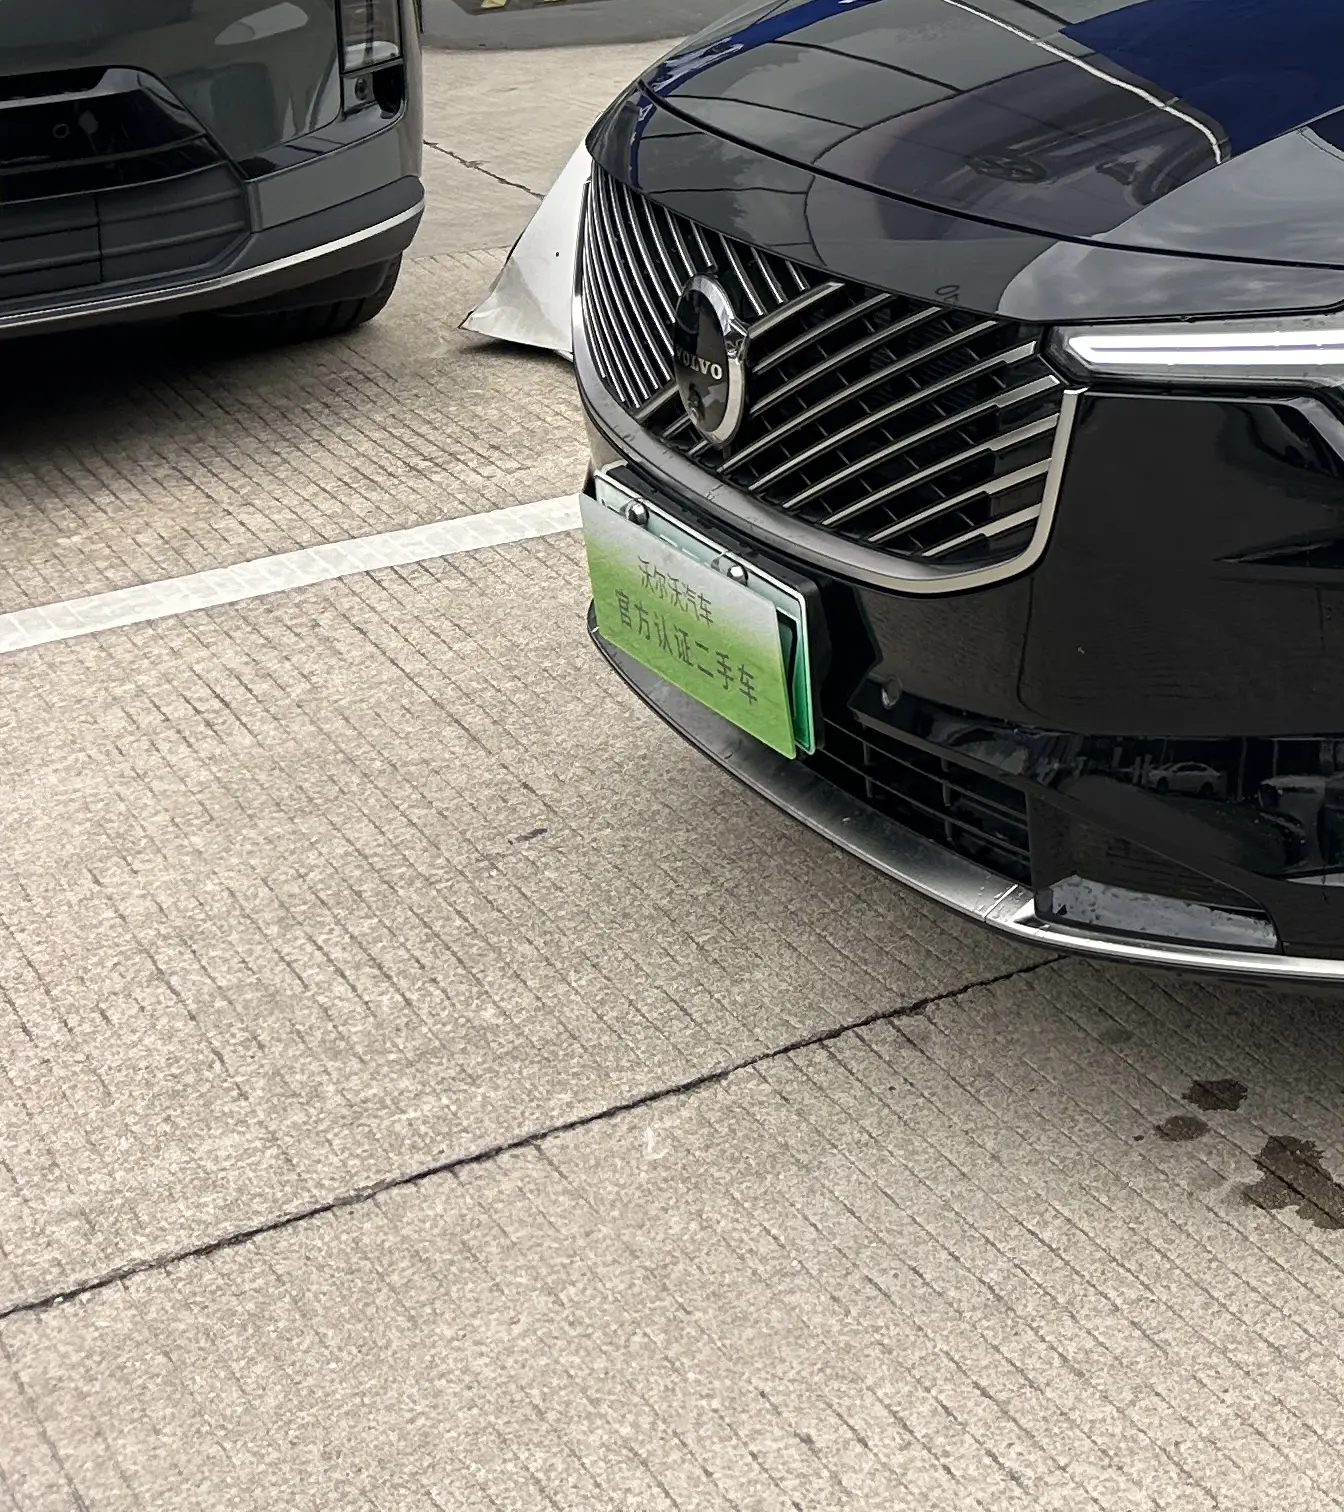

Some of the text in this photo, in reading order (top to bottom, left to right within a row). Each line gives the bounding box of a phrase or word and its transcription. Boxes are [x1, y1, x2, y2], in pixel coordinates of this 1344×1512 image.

[637, 555, 714, 628] 沃尔沃汽车
[614, 588, 758, 705] 官方认证二手车
